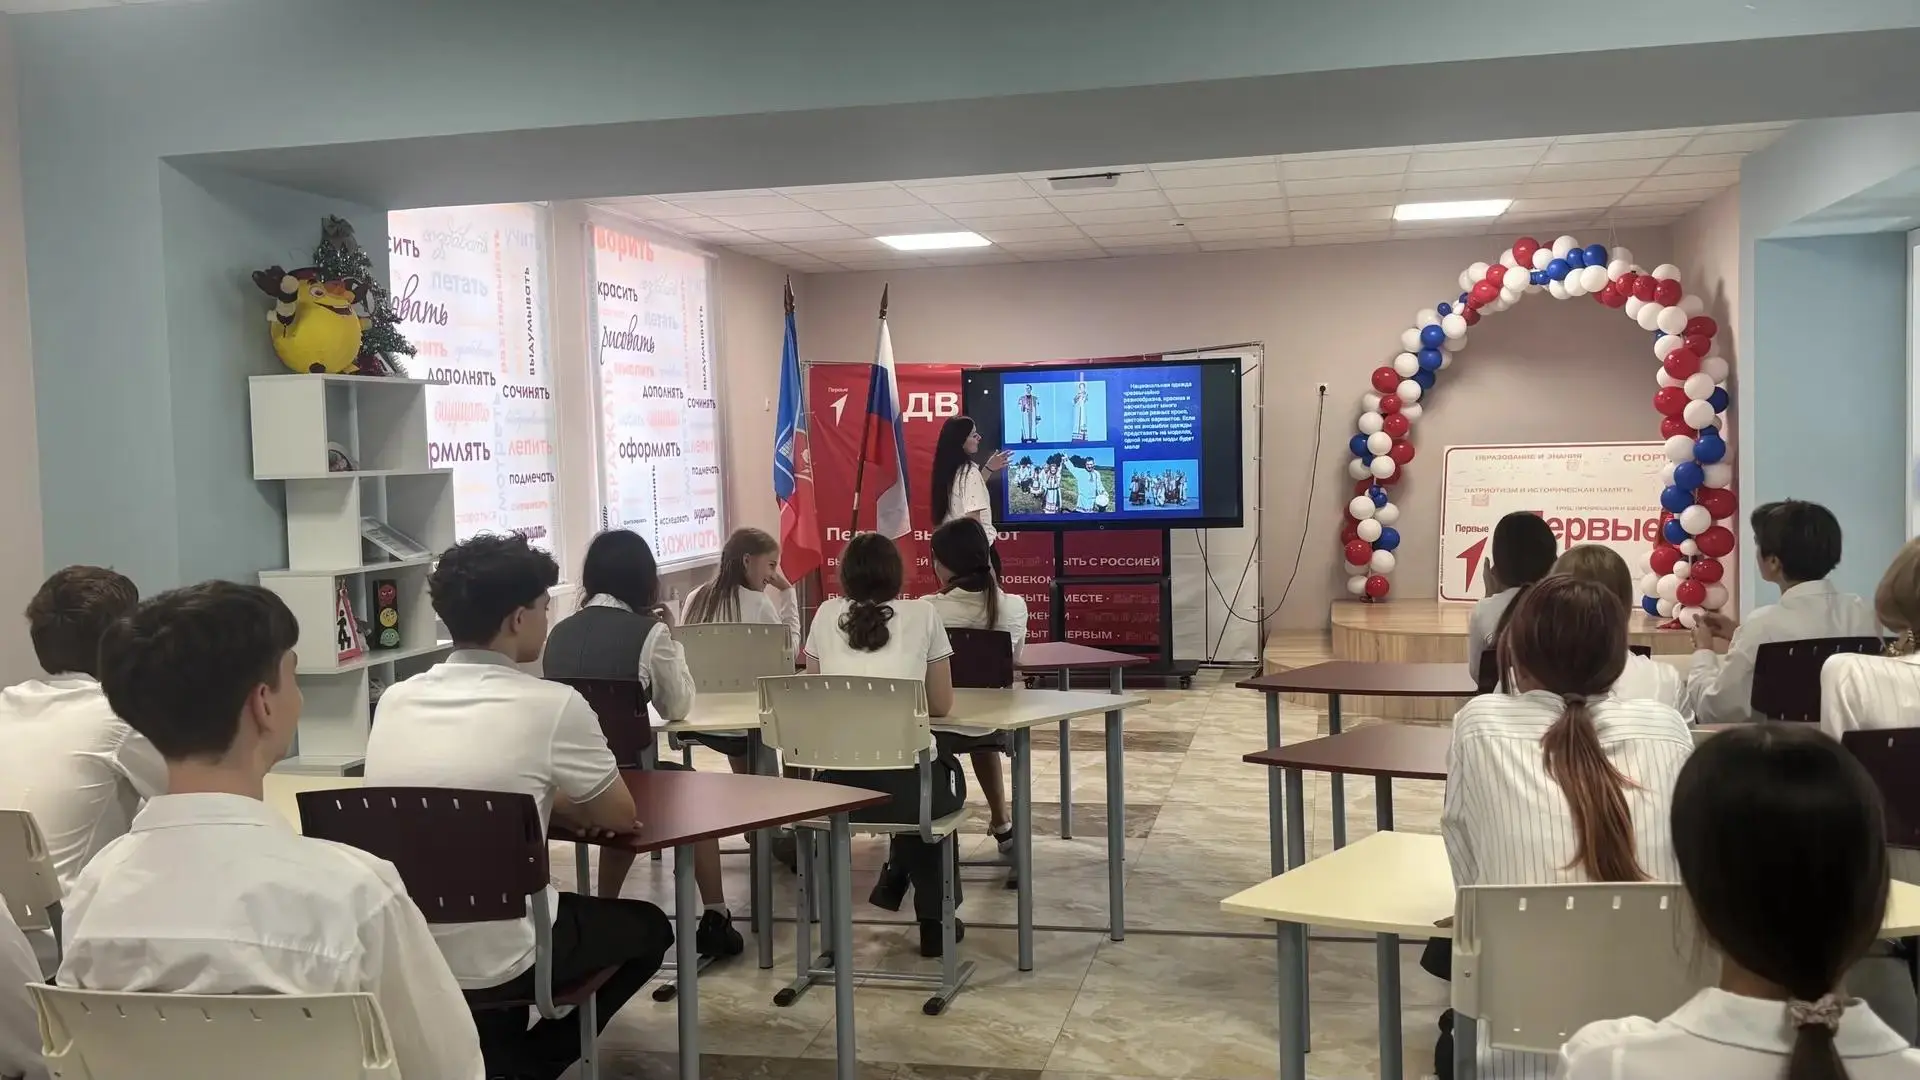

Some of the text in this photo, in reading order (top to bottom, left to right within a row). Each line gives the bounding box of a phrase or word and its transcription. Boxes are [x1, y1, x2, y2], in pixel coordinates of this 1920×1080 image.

[597, 280, 638, 302] красить
[600, 314, 655, 365] рисовать
[502, 384, 550, 400] сочинять
[642, 385, 684, 399] дополнять
[687, 396, 716, 410] сочинять
[619, 437, 681, 463] оформлять
[509, 472, 555, 485] подмечать
[1455, 524, 1489, 533] Первые
[1524, 511, 1661, 550] ервые
[1053, 557, 1087, 566] ЫТЬ
[1089, 557, 1098, 566] С
[1100, 555, 1160, 567] РОССИЕЙ
